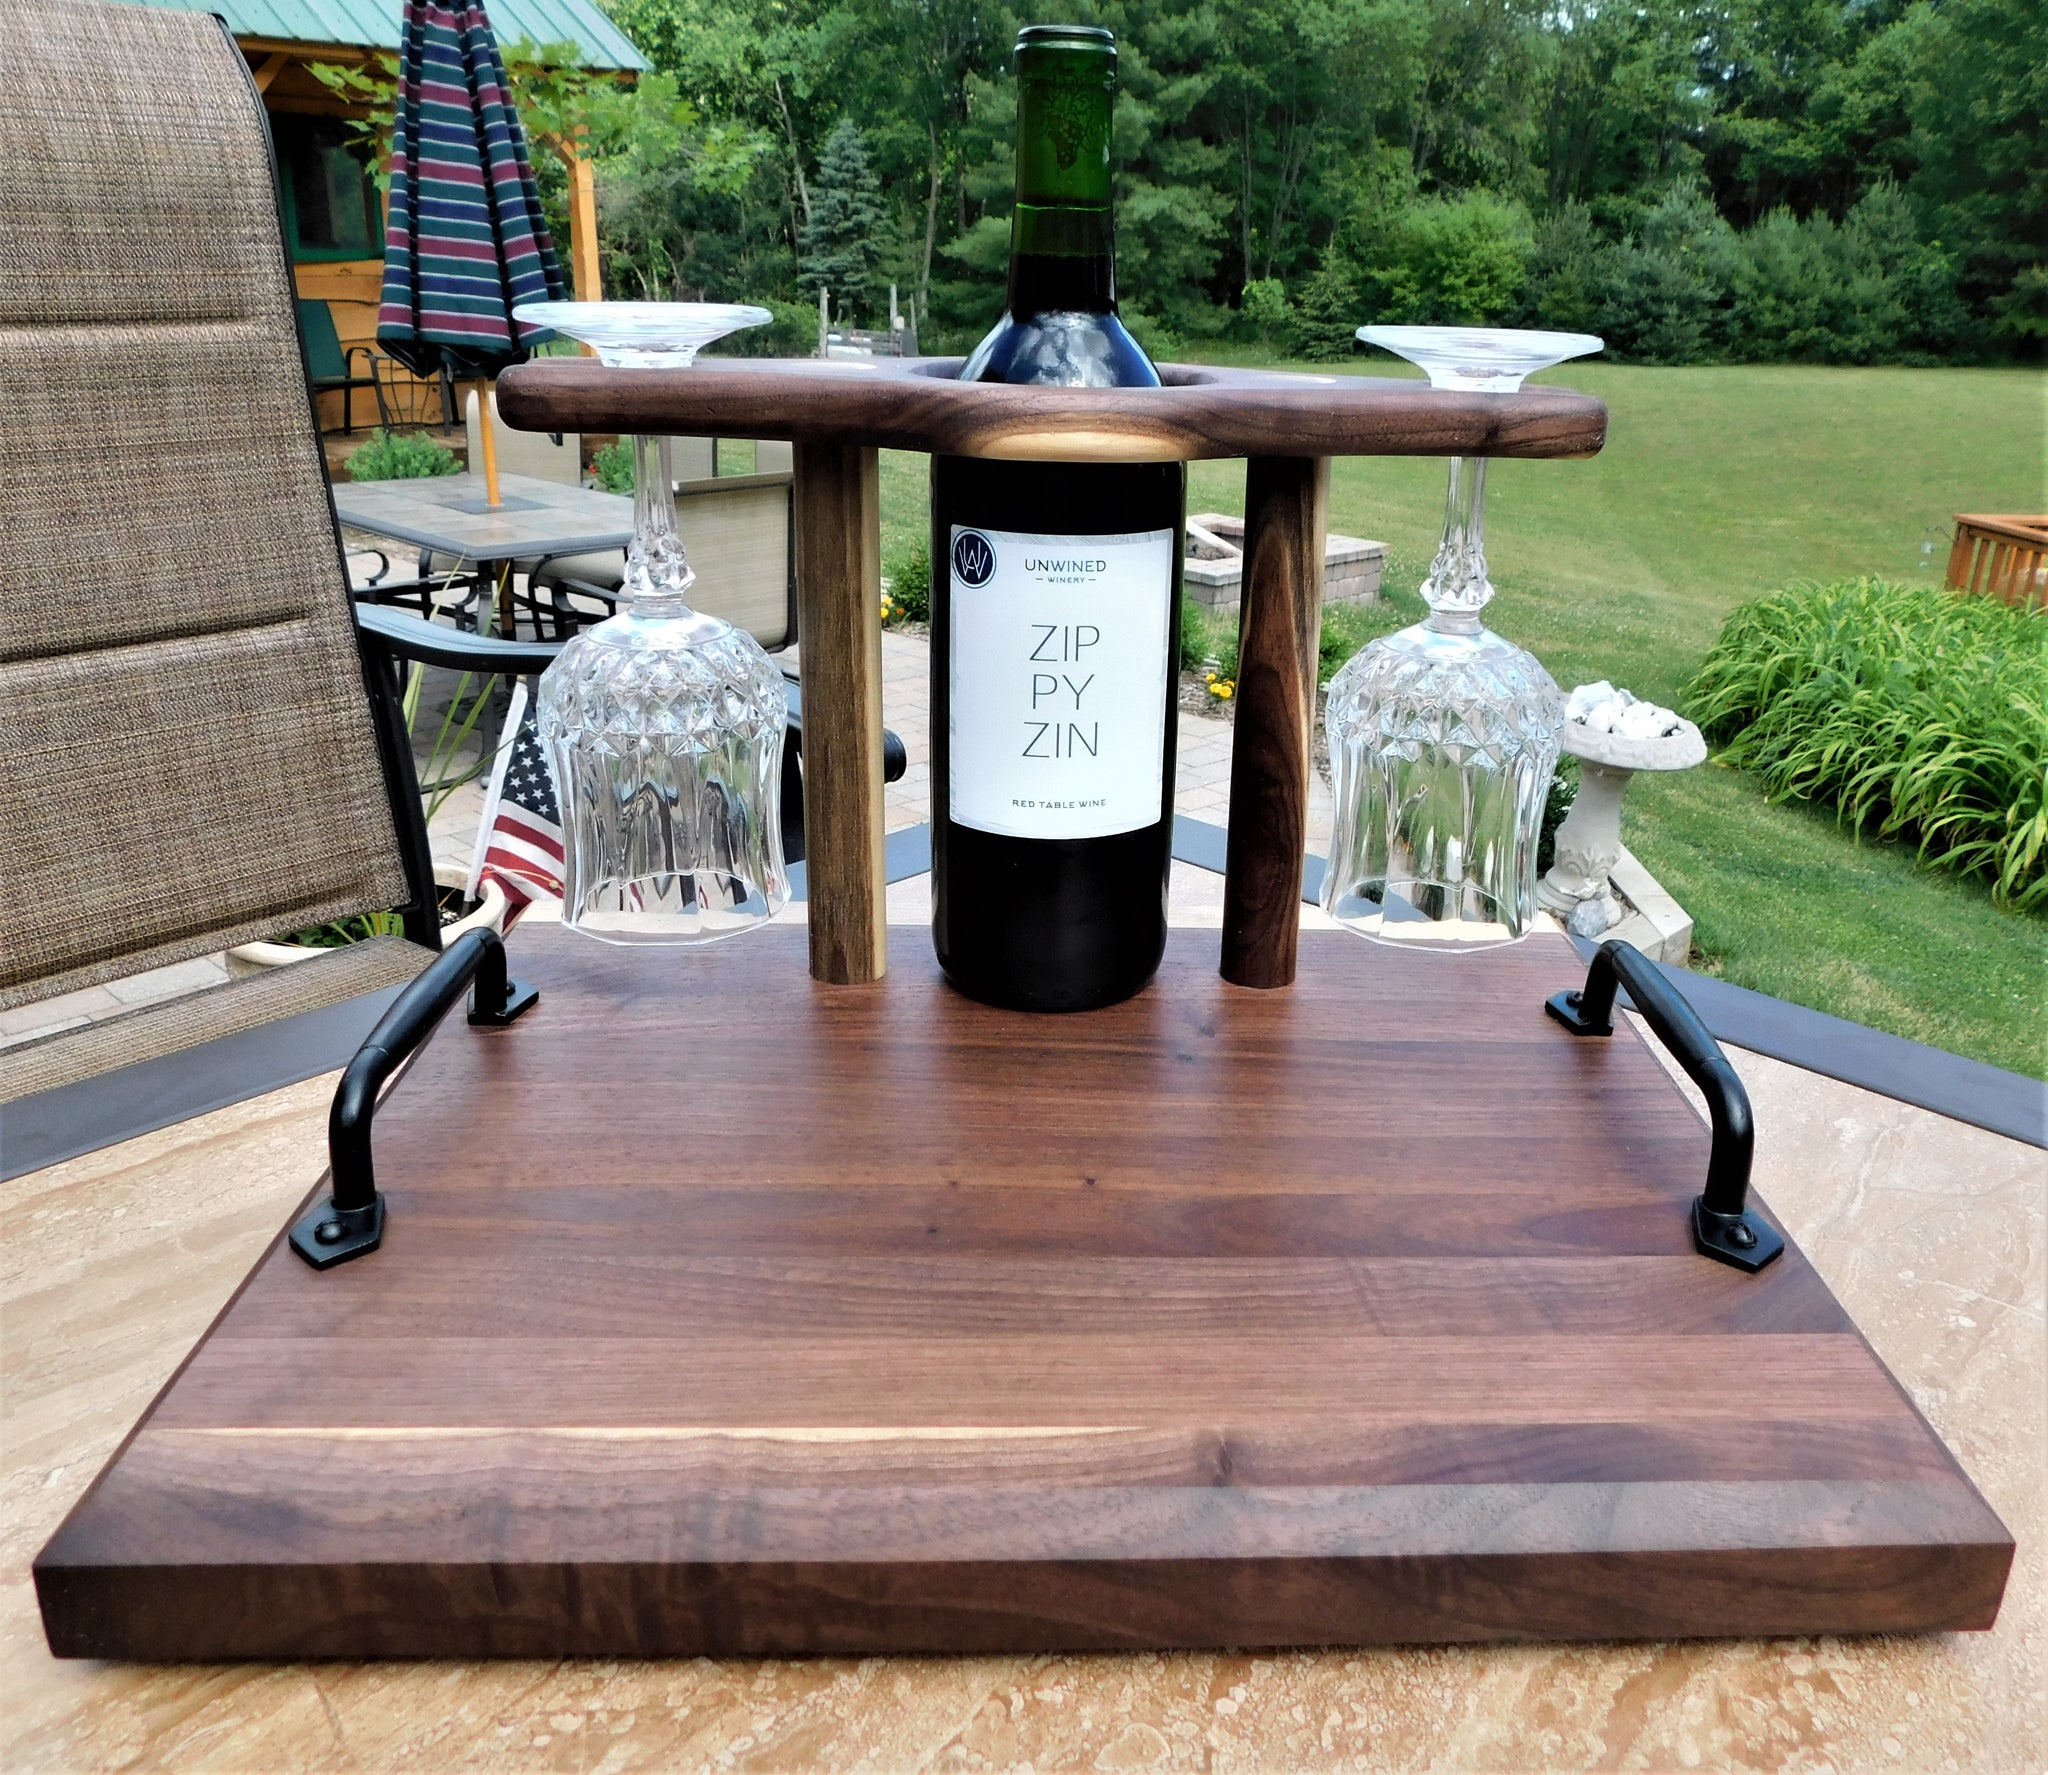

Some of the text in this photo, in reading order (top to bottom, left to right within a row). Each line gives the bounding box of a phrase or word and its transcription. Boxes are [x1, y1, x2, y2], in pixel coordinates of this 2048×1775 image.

[1024, 558, 1107, 573] UNWINED
[1047, 576, 1085, 584] WINERY
[1029, 624, 1100, 662] ZIP
[1032, 673, 1095, 711] PY
[1021, 721, 1098, 759] ZIN
[1012, 798, 1107, 809] RED TABLE WINE
